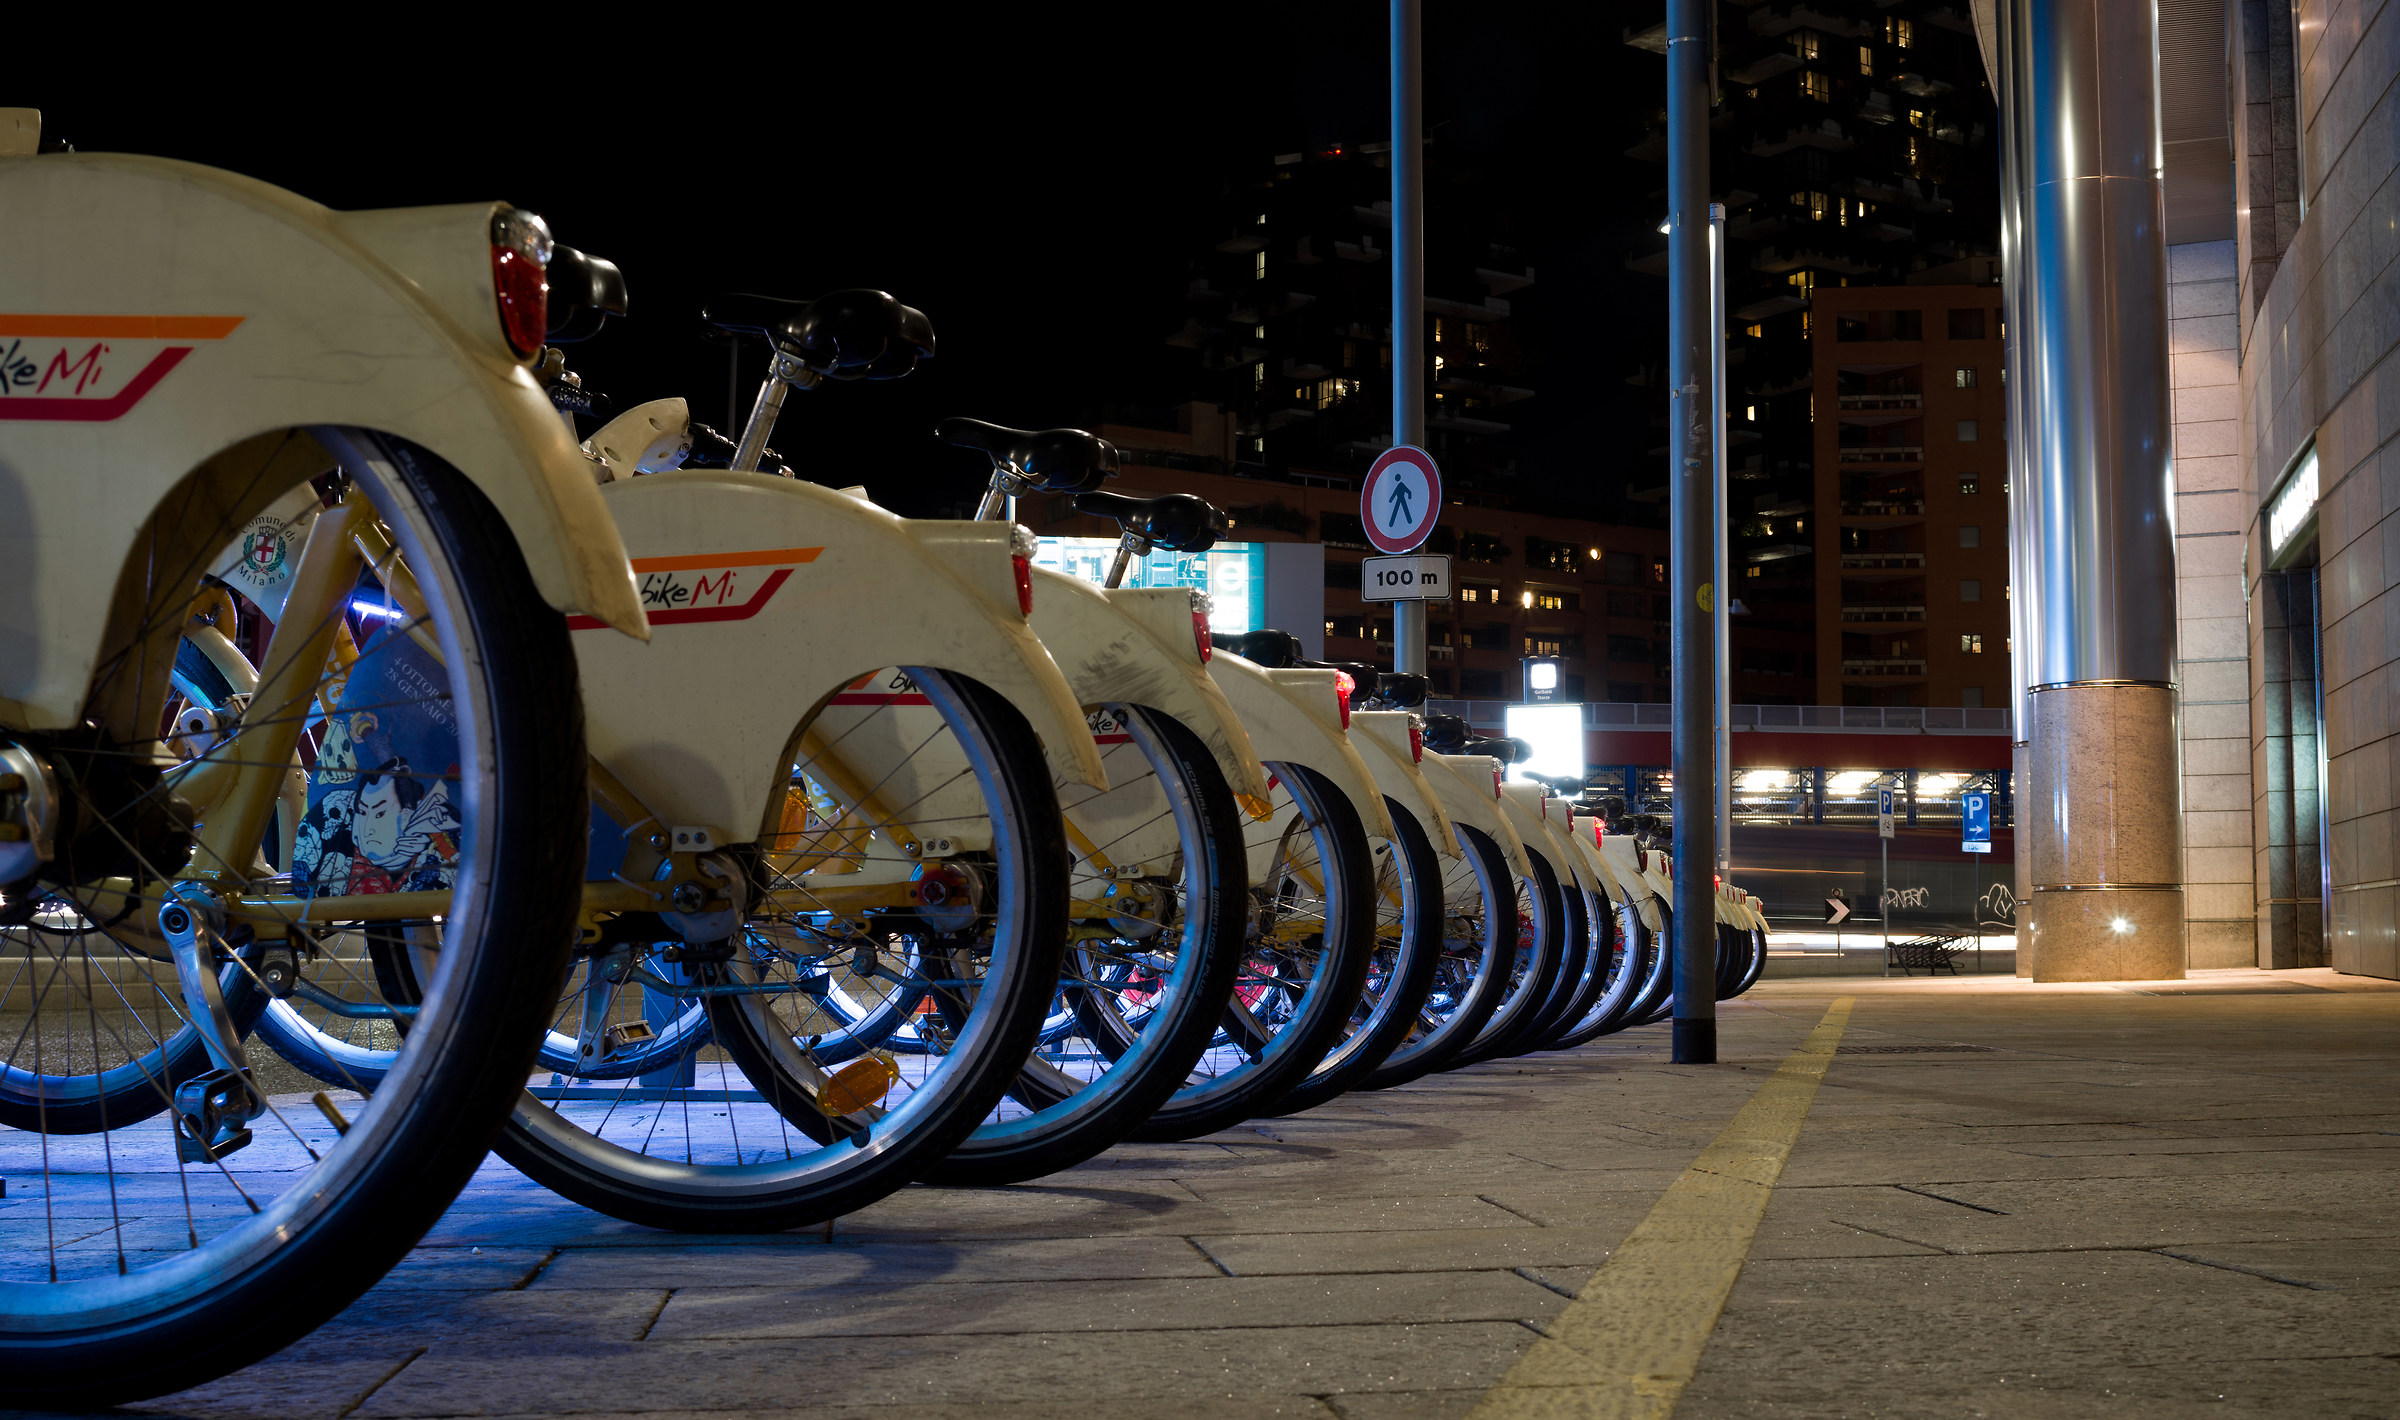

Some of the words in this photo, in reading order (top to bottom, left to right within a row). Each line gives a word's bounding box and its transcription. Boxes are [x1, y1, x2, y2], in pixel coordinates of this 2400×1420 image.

[0, 339, 110, 396] keMi
[396, 448, 439, 505] PLUS
[239, 564, 285, 586] Milano
[1376, 569, 1413, 587] 100
[1420, 572, 1438, 586] m
[641, 569, 737, 609] bikeMi
[393, 657, 403, 666] 4
[384, 668, 400, 682] 28
[1182, 760, 1213, 834] SCHWALBE
[1882, 794, 1891, 812] P
[1968, 796, 1984, 820] P
